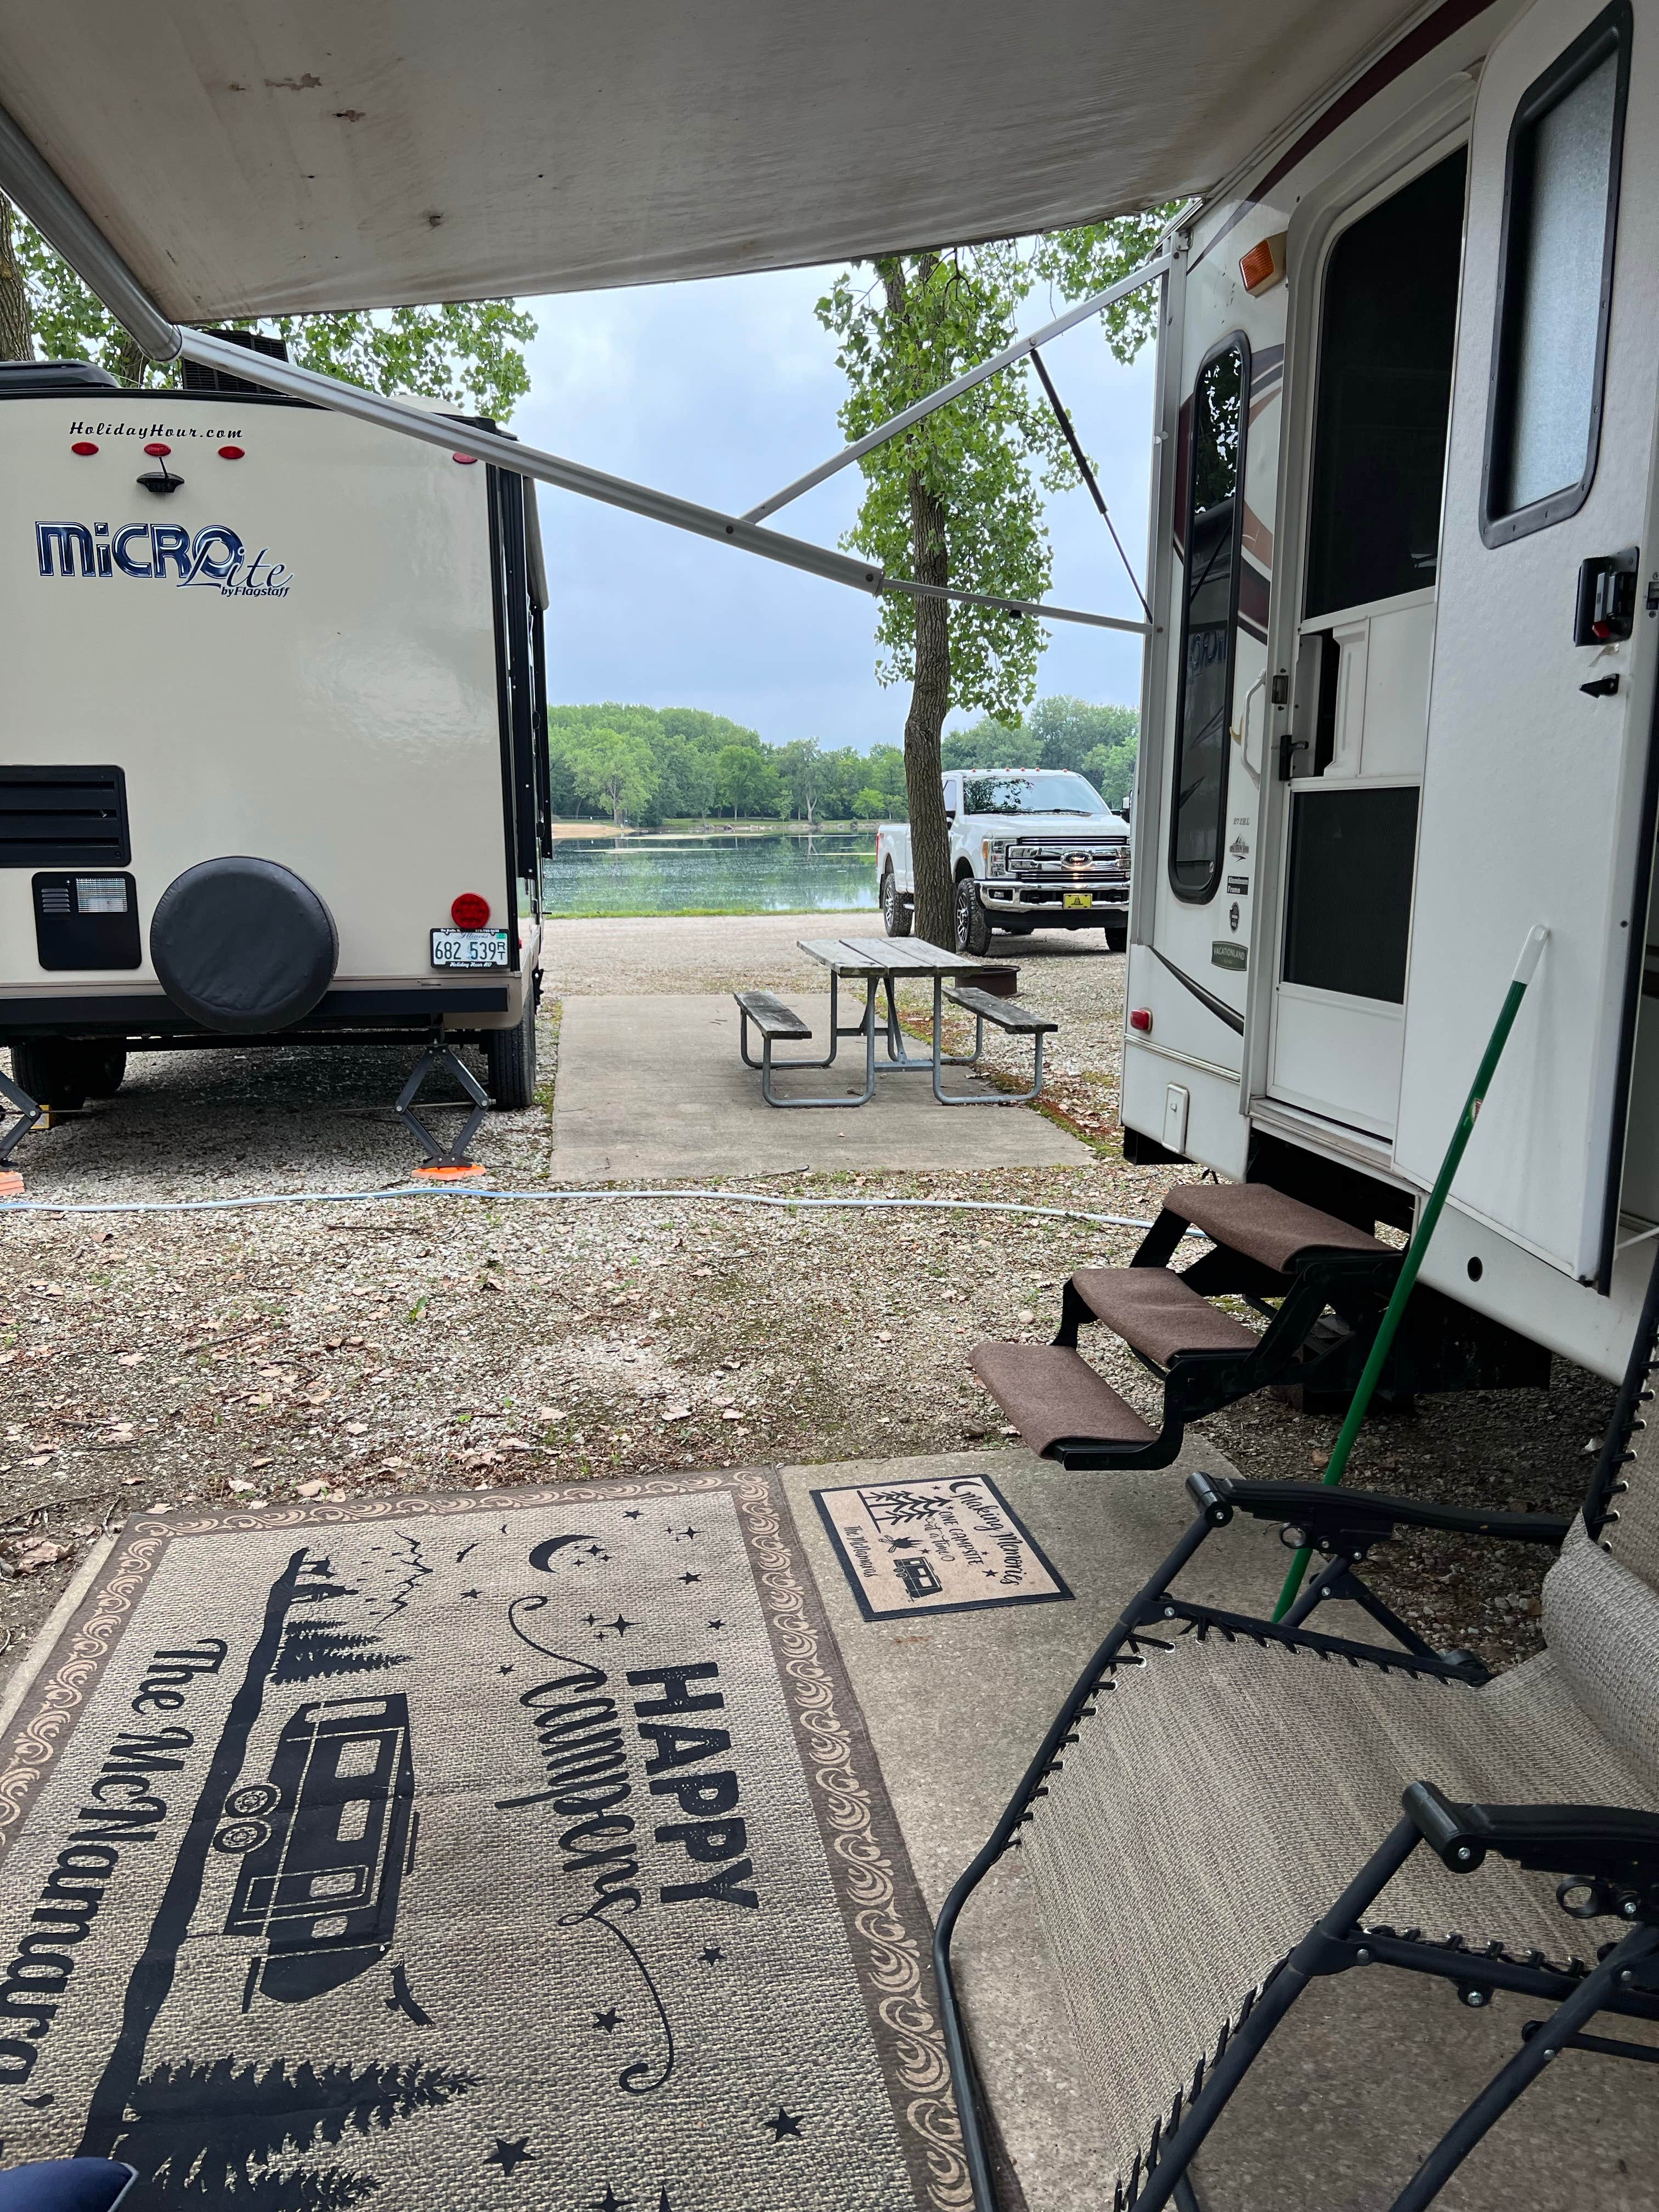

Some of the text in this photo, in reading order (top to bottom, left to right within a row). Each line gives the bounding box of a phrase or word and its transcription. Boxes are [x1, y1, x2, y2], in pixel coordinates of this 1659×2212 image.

[70, 421, 242, 439] HolidayHour.com
[177, 538, 294, 588] Lite
[436, 941, 461, 959] 682
[470, 941, 496, 960] 539
[1214, 947, 1245, 960] VACATIONLAND
[844, 1525, 878, 1577] The McNamaras
[924, 1520, 942, 1534] at
[933, 1536, 955, 1561] time
[939, 1511, 984, 1566] ONE CAMPSITE
[950, 1491, 1027, 1585] Making Memories
[626, 1662, 760, 1910] HAPPY
[0, 1638, 228, 2158] The McNamara'
